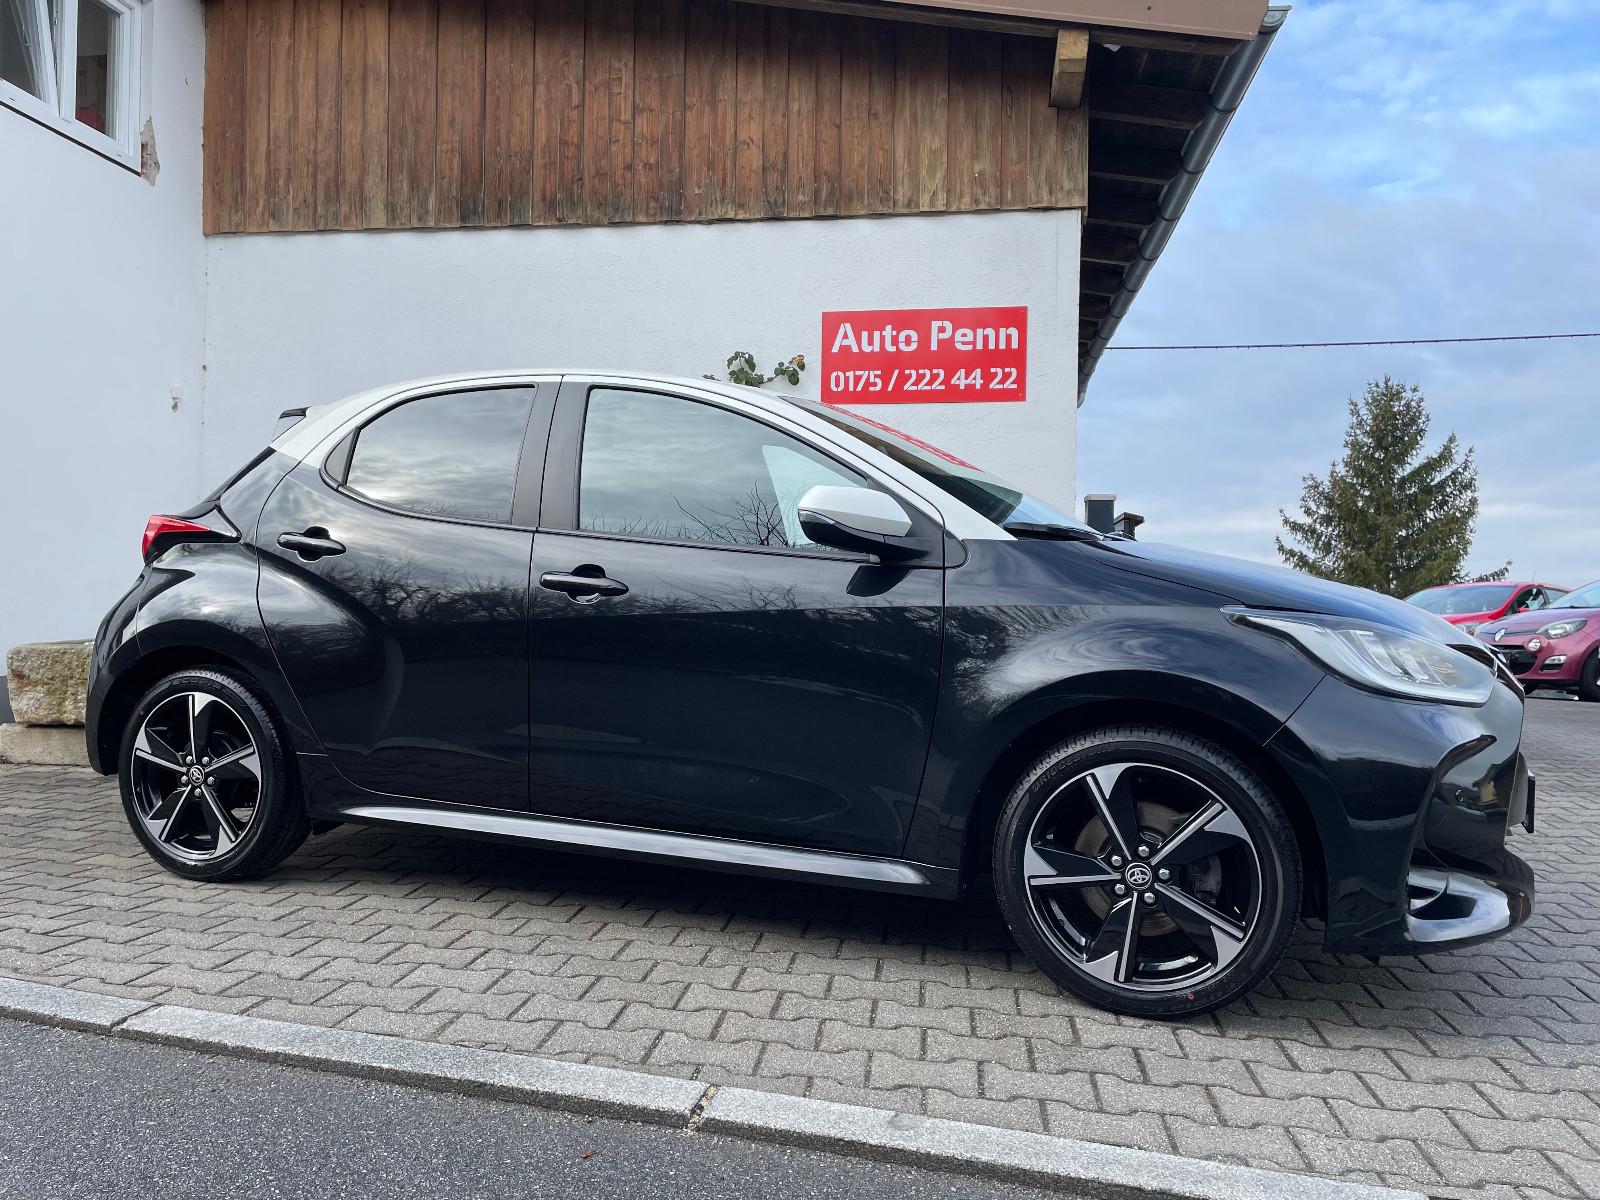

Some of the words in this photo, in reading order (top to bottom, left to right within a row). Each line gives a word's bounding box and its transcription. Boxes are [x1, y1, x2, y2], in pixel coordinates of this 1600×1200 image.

[831, 322, 918, 352] Auto
[930, 320, 1019, 351] Penn
[830, 369, 882, 391] 0175
[887, 369, 900, 391] /
[903, 368, 946, 391] 222
[950, 368, 984, 390] 44
[988, 367, 1018, 389] 22
